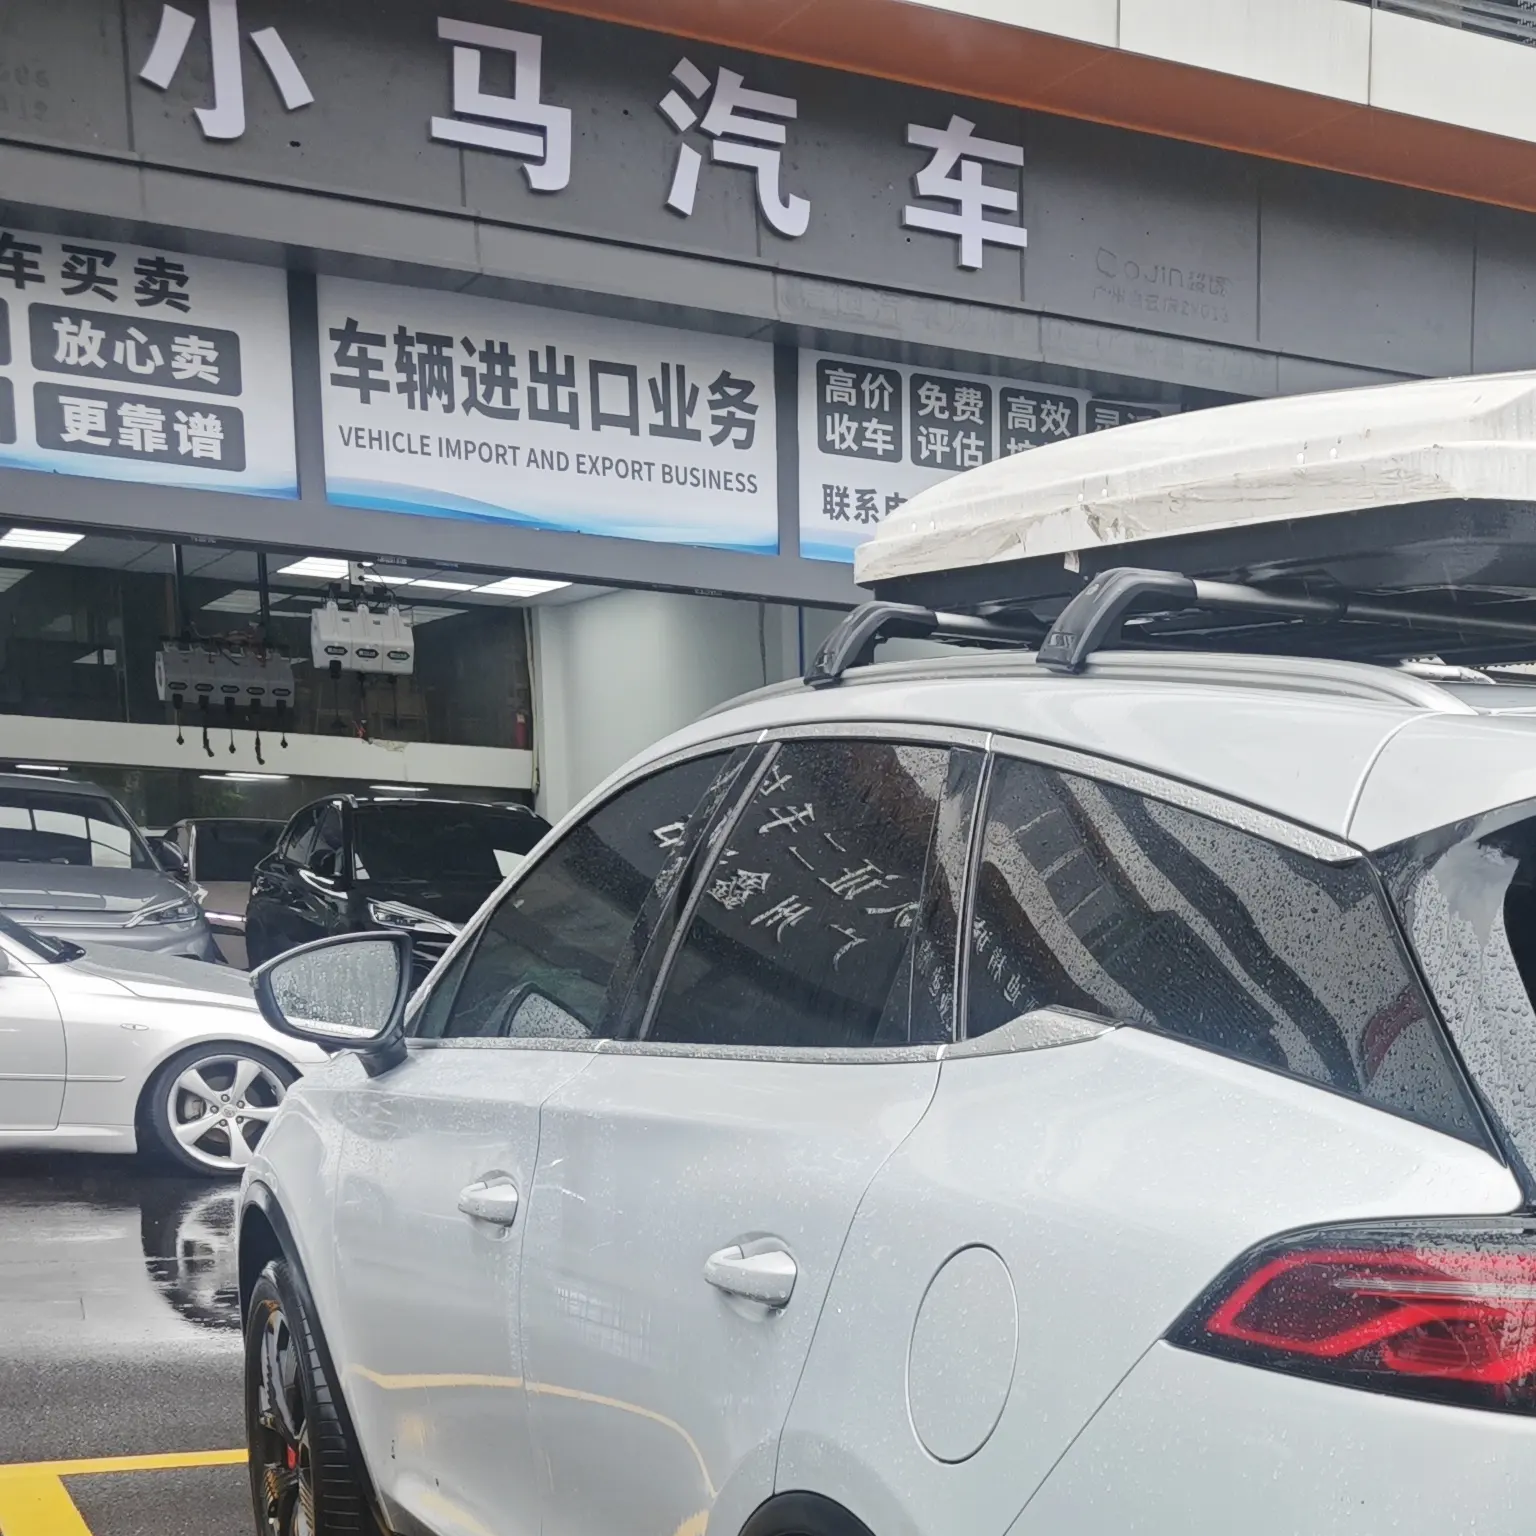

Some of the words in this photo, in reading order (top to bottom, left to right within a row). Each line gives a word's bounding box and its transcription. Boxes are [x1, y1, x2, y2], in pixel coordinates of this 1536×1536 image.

[138, 0, 1028, 271] 小马汽车
[52, 316, 221, 385] 放心卖
[328, 316, 759, 450] 车辆进出口业务
[58, 395, 224, 461] 更靠谱
[824, 367, 895, 412] 高价
[917, 381, 984, 425] 免费
[1006, 396, 1072, 437] 高效
[338, 424, 432, 457] VEHICLE
[438, 436, 520, 467] IMPORT
[526, 447, 570, 472] AND
[575, 453, 655, 482] EXPORT
[661, 463, 758, 494] BUSINESS
[825, 412, 895, 456] 收车
[917, 425, 985, 468] 评估
